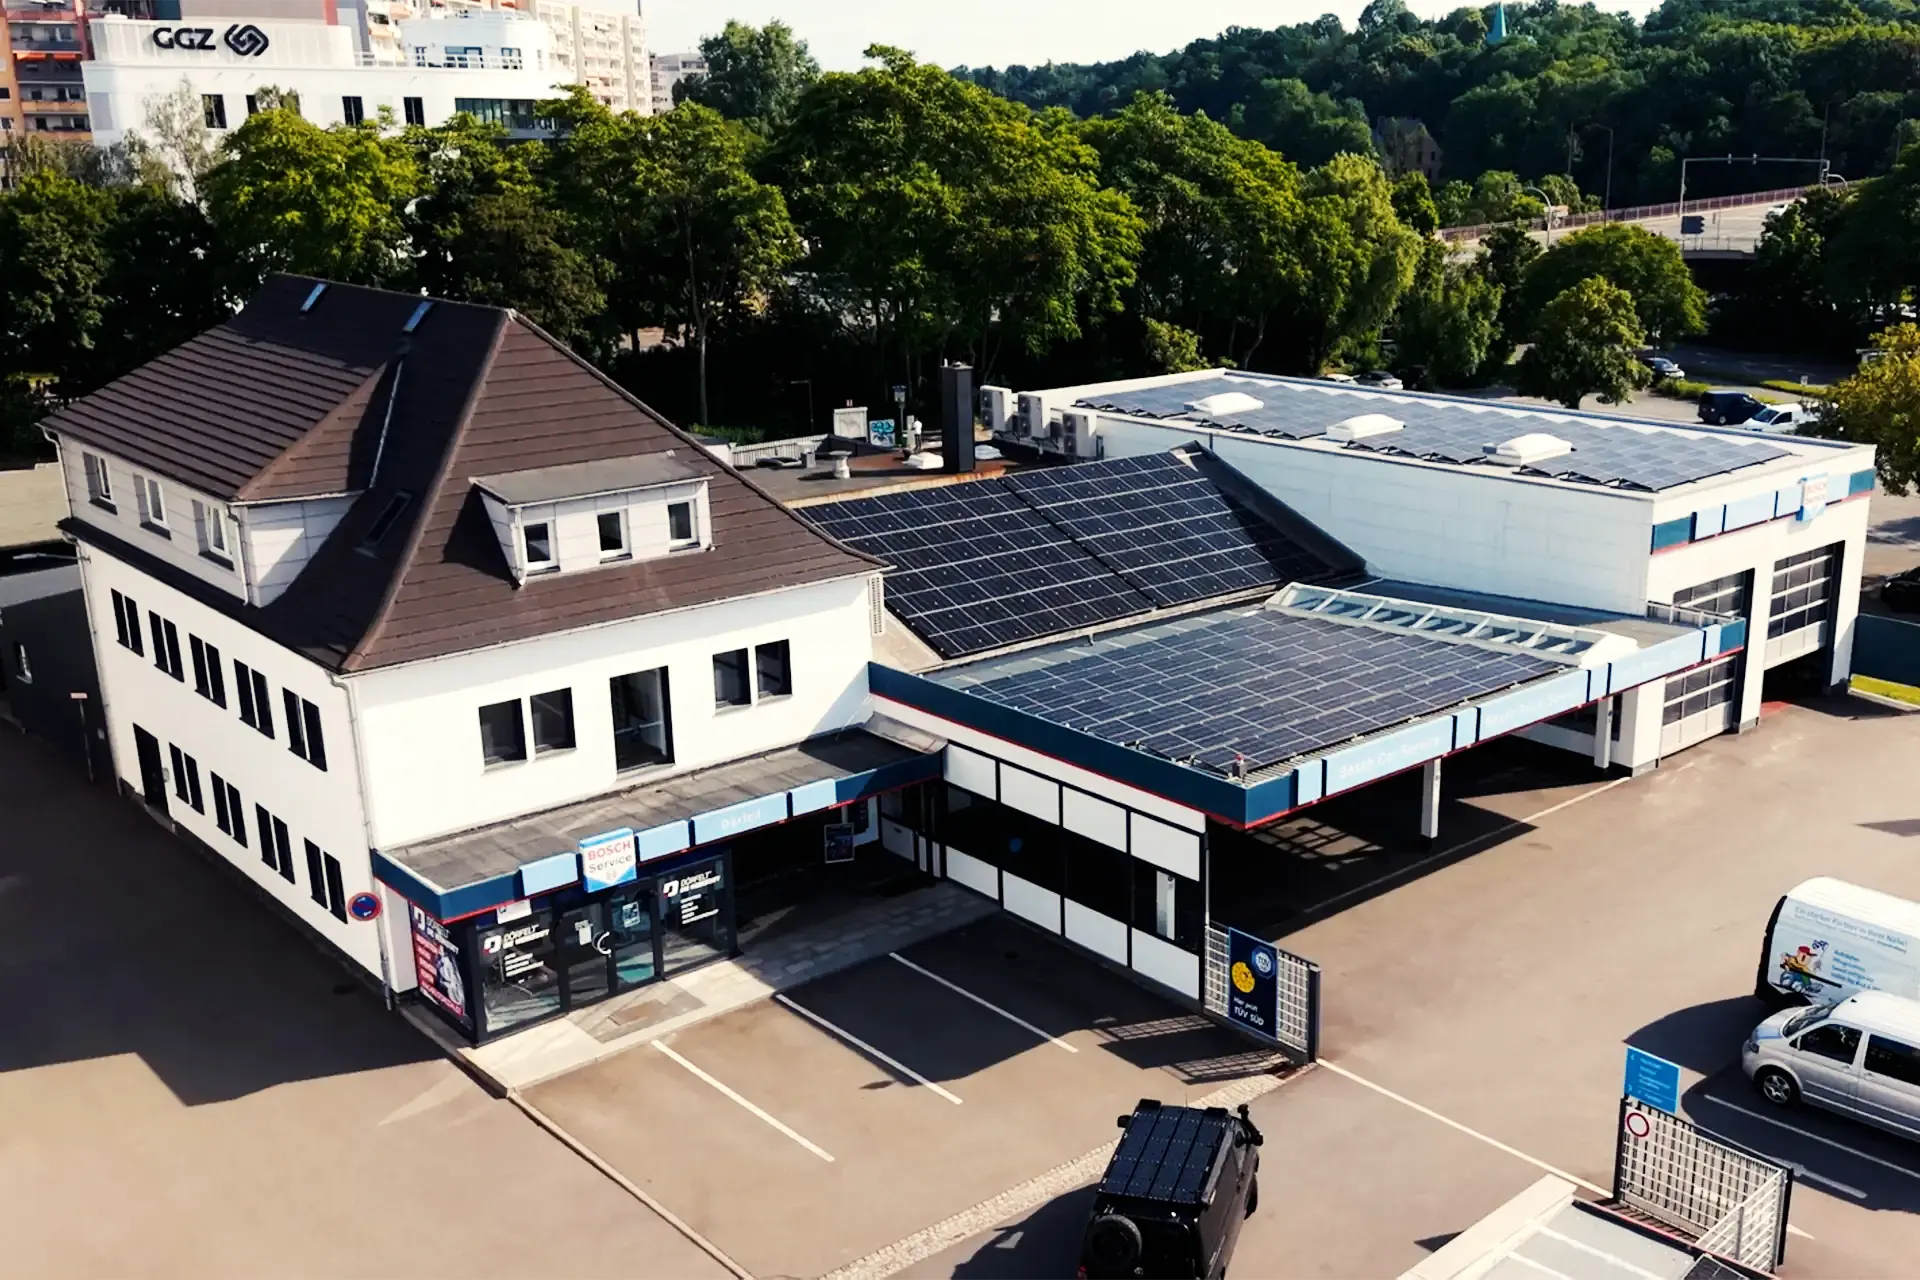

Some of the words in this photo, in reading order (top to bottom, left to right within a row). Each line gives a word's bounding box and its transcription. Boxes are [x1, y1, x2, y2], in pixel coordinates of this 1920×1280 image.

[153, 27, 216, 50] GGZ
[587, 840, 631, 860] BOSCH
[588, 855, 632, 873] Service
[1234, 1006, 1248, 1018] TÜV
[1250, 1013, 1265, 1026] SÜD
